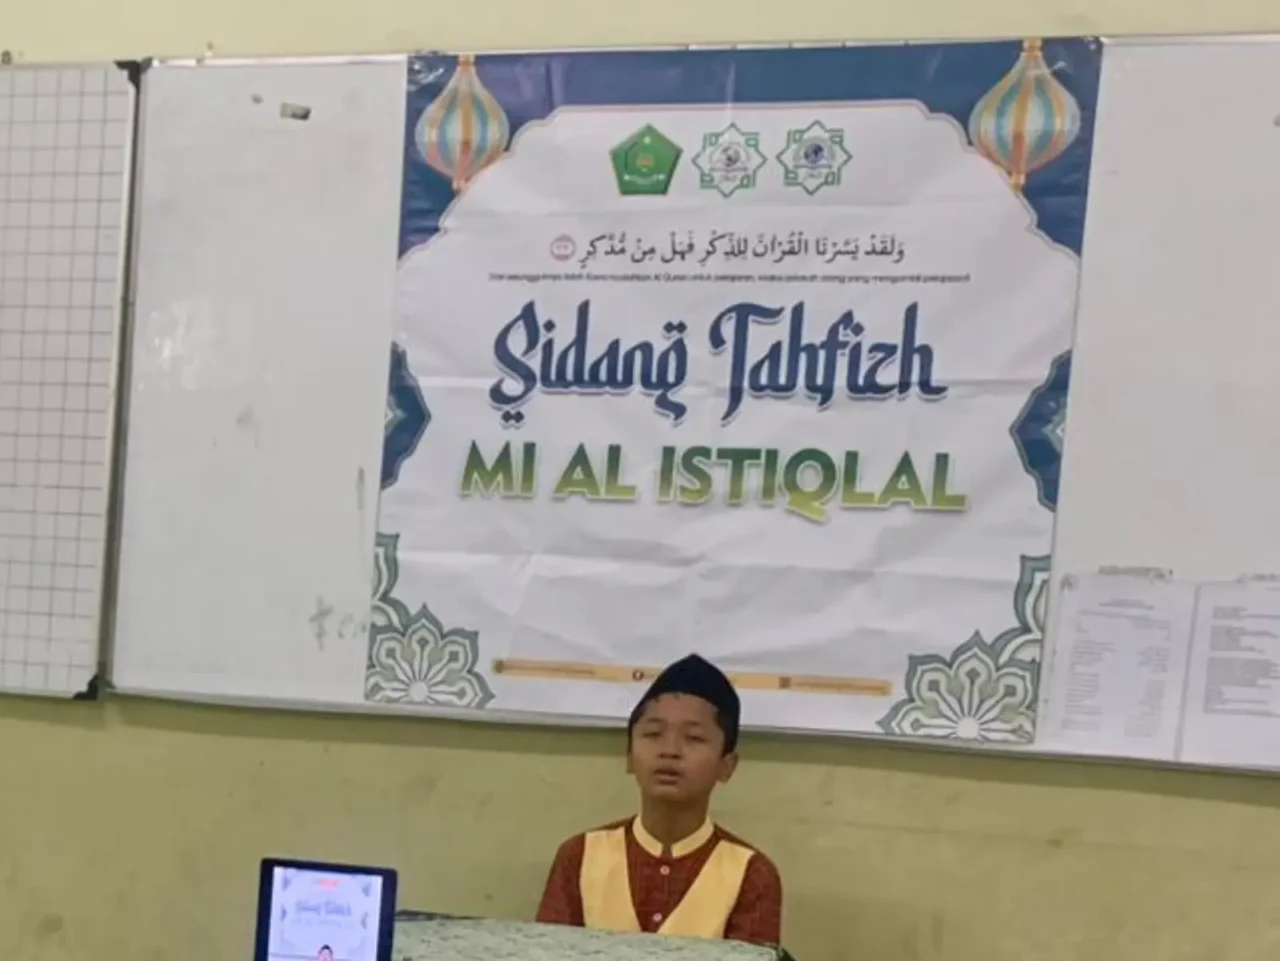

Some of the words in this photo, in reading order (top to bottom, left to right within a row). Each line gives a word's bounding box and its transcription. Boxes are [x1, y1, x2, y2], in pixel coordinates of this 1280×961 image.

[489, 298, 688, 427] Sidang
[708, 300, 949, 427] Tahfizh
[460, 438, 538, 498] MI
[552, 441, 638, 500] AL
[656, 444, 969, 524] ISTIQLAL
